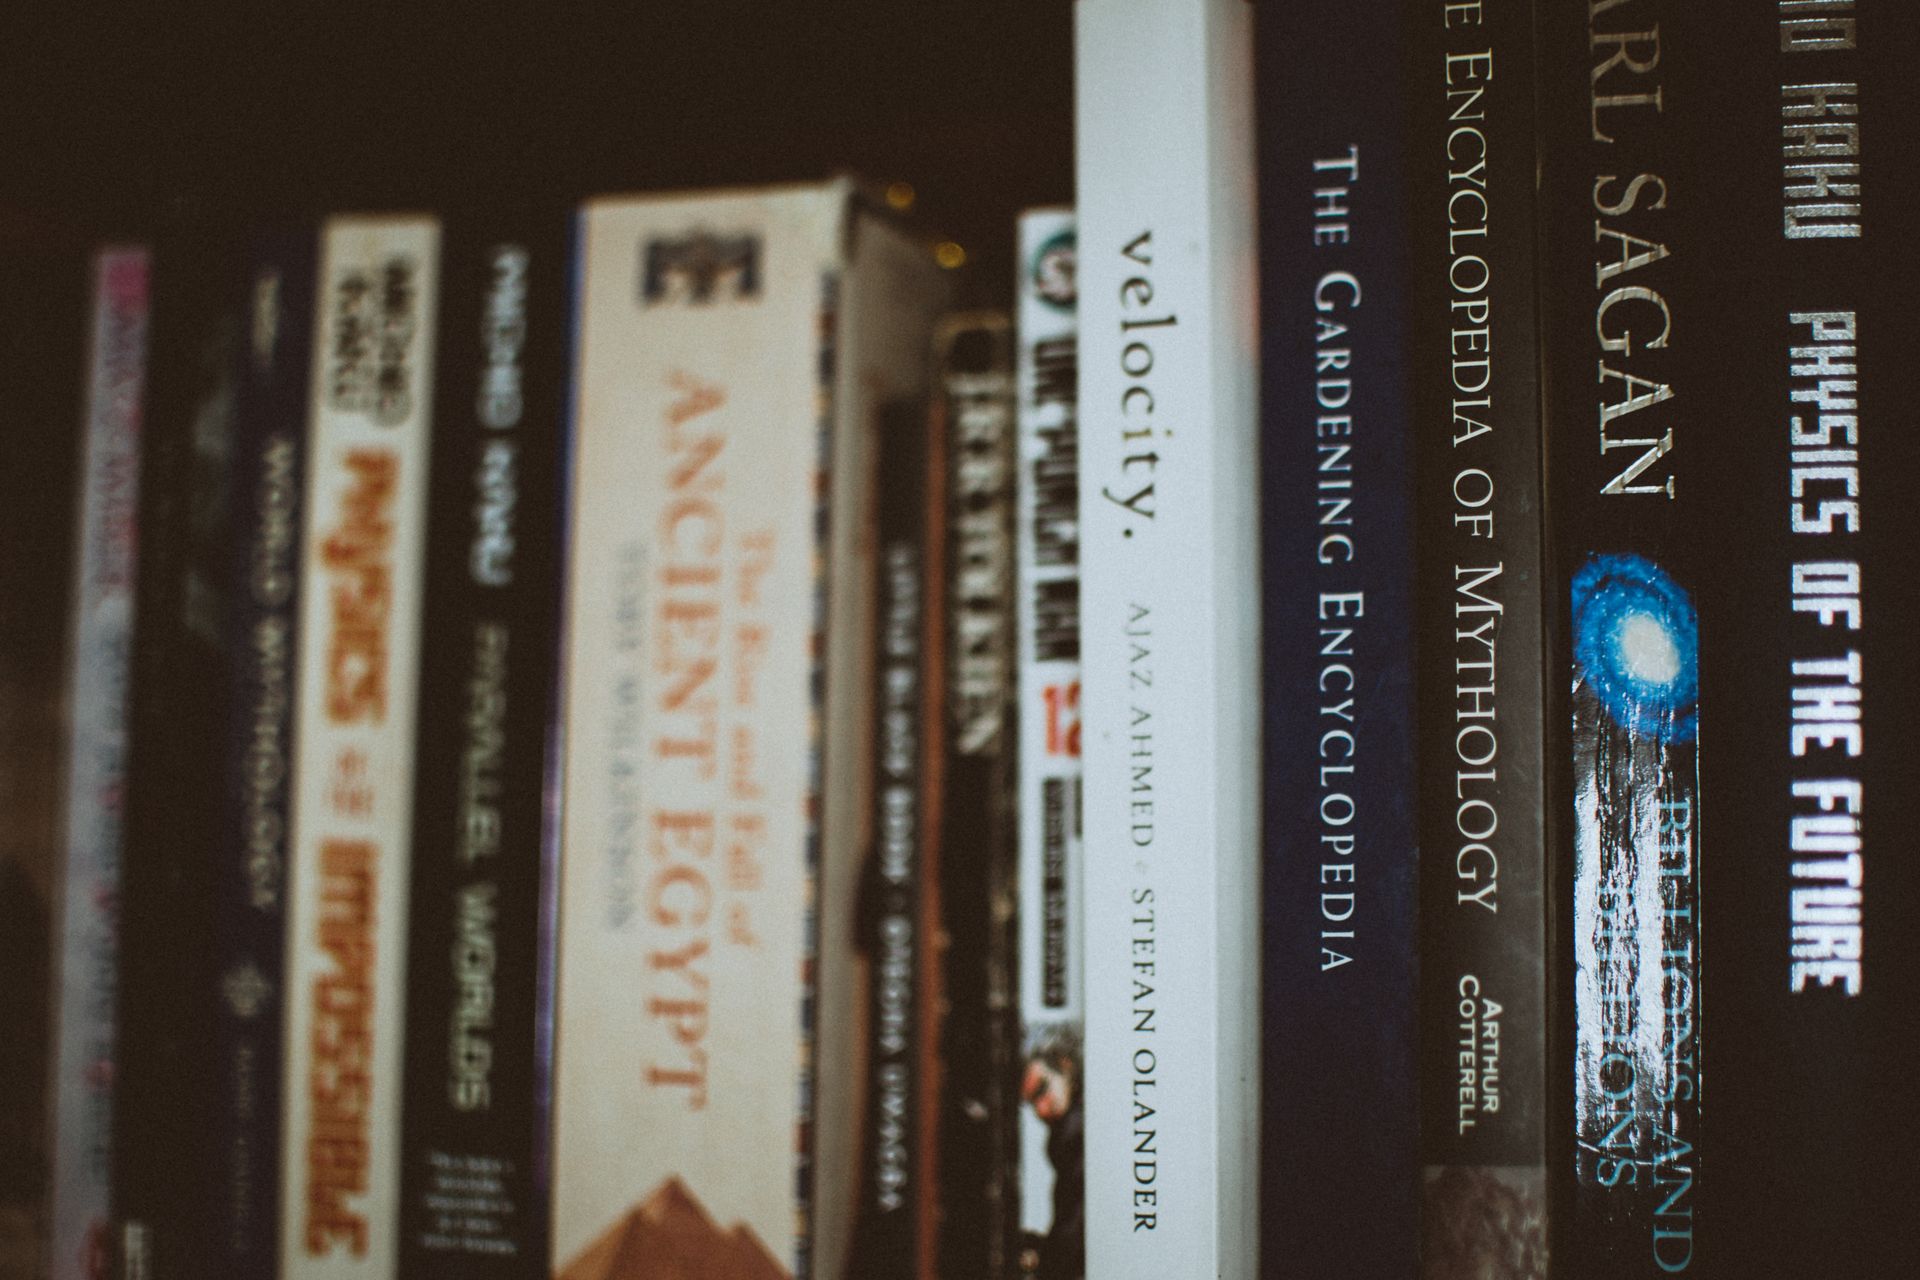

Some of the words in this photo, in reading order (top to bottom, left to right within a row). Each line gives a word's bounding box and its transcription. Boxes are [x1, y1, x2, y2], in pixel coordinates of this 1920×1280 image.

[1312, 144, 1360, 247] THE
[1782, 82, 1862, 240] KAKU
[1445, 48, 1495, 447] ENCYCLOPEDIA
[1101, 230, 1178, 539] velocity.
[1314, 270, 1363, 566] GARDENING
[1592, 174, 1677, 501] SAGAN
[1789, 311, 1861, 533] PHYSICS
[652, 369, 730, 781] ANCIENT
[1452, 469, 1494, 539] OF
[1124, 604, 1153, 690] AJAZ
[1790, 562, 1863, 629] OF
[1129, 706, 1154, 848] AHMED
[1318, 591, 1364, 972] ENCYCLOPEDIA
[1454, 562, 1503, 913] MYTHOLOGY
[1791, 650, 1863, 758] THE
[642, 809, 718, 1112] EGYPT
[1132, 888, 1156, 1033] STEFAN
[1790, 779, 1863, 998] FUTURE
[1458, 975, 1480, 1134] COTTERELL
[1481, 997, 1502, 1113] ARTHUR
[1132, 1049, 1157, 1234] OLANDER
[1652, 1127, 1693, 1273] AND
